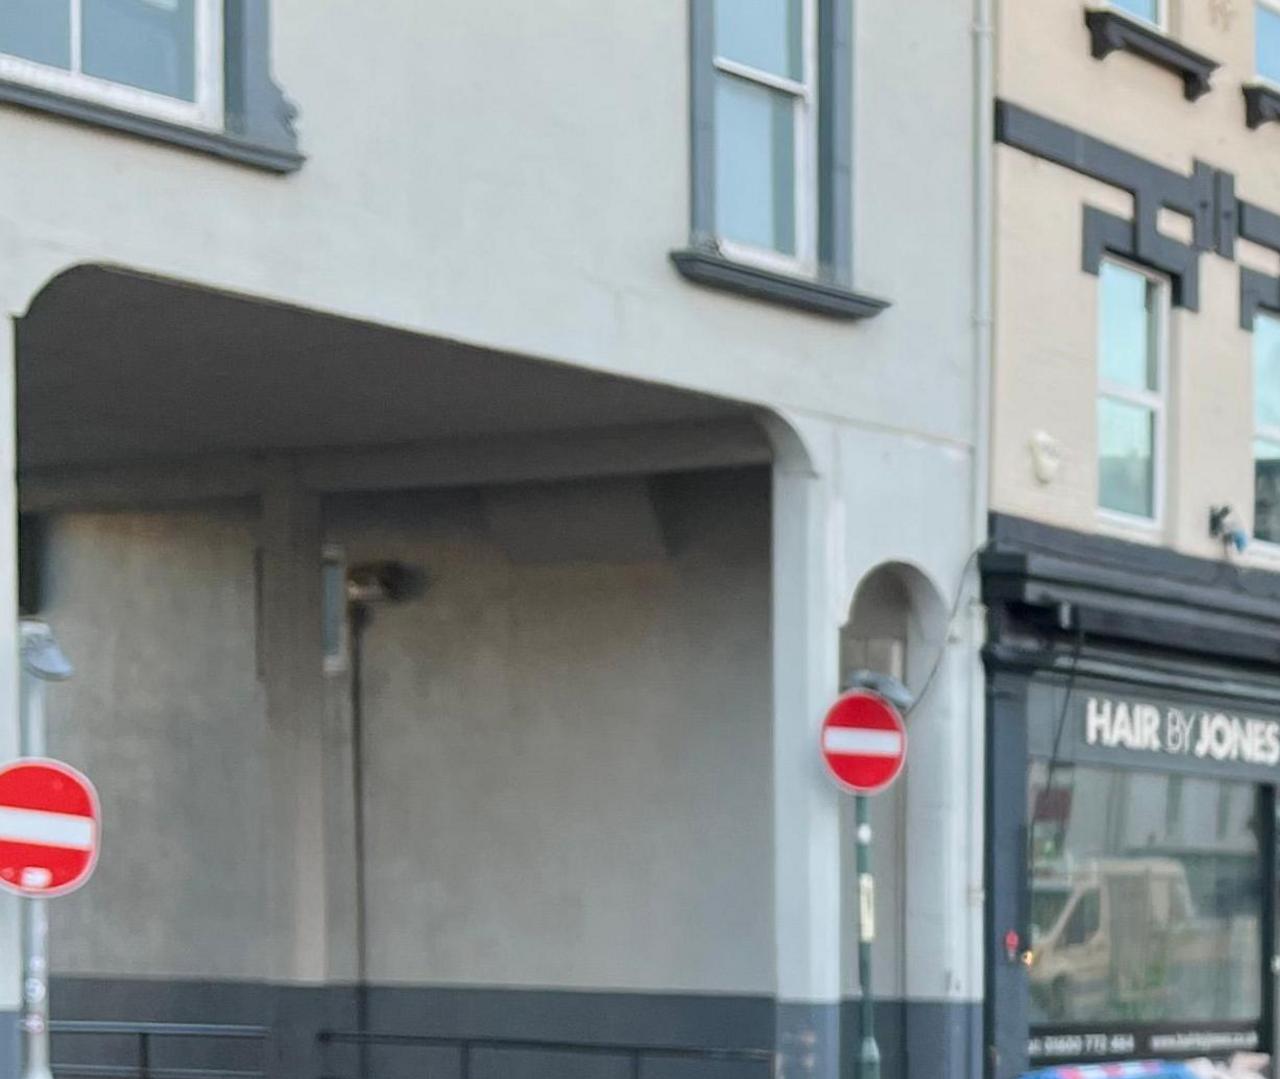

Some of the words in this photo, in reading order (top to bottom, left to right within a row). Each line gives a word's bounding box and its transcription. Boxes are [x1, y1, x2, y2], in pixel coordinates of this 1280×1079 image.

[1086, 698, 1161, 751] HAIR
[1166, 707, 1195, 754] BY
[1194, 712, 1280, 767] JONES
